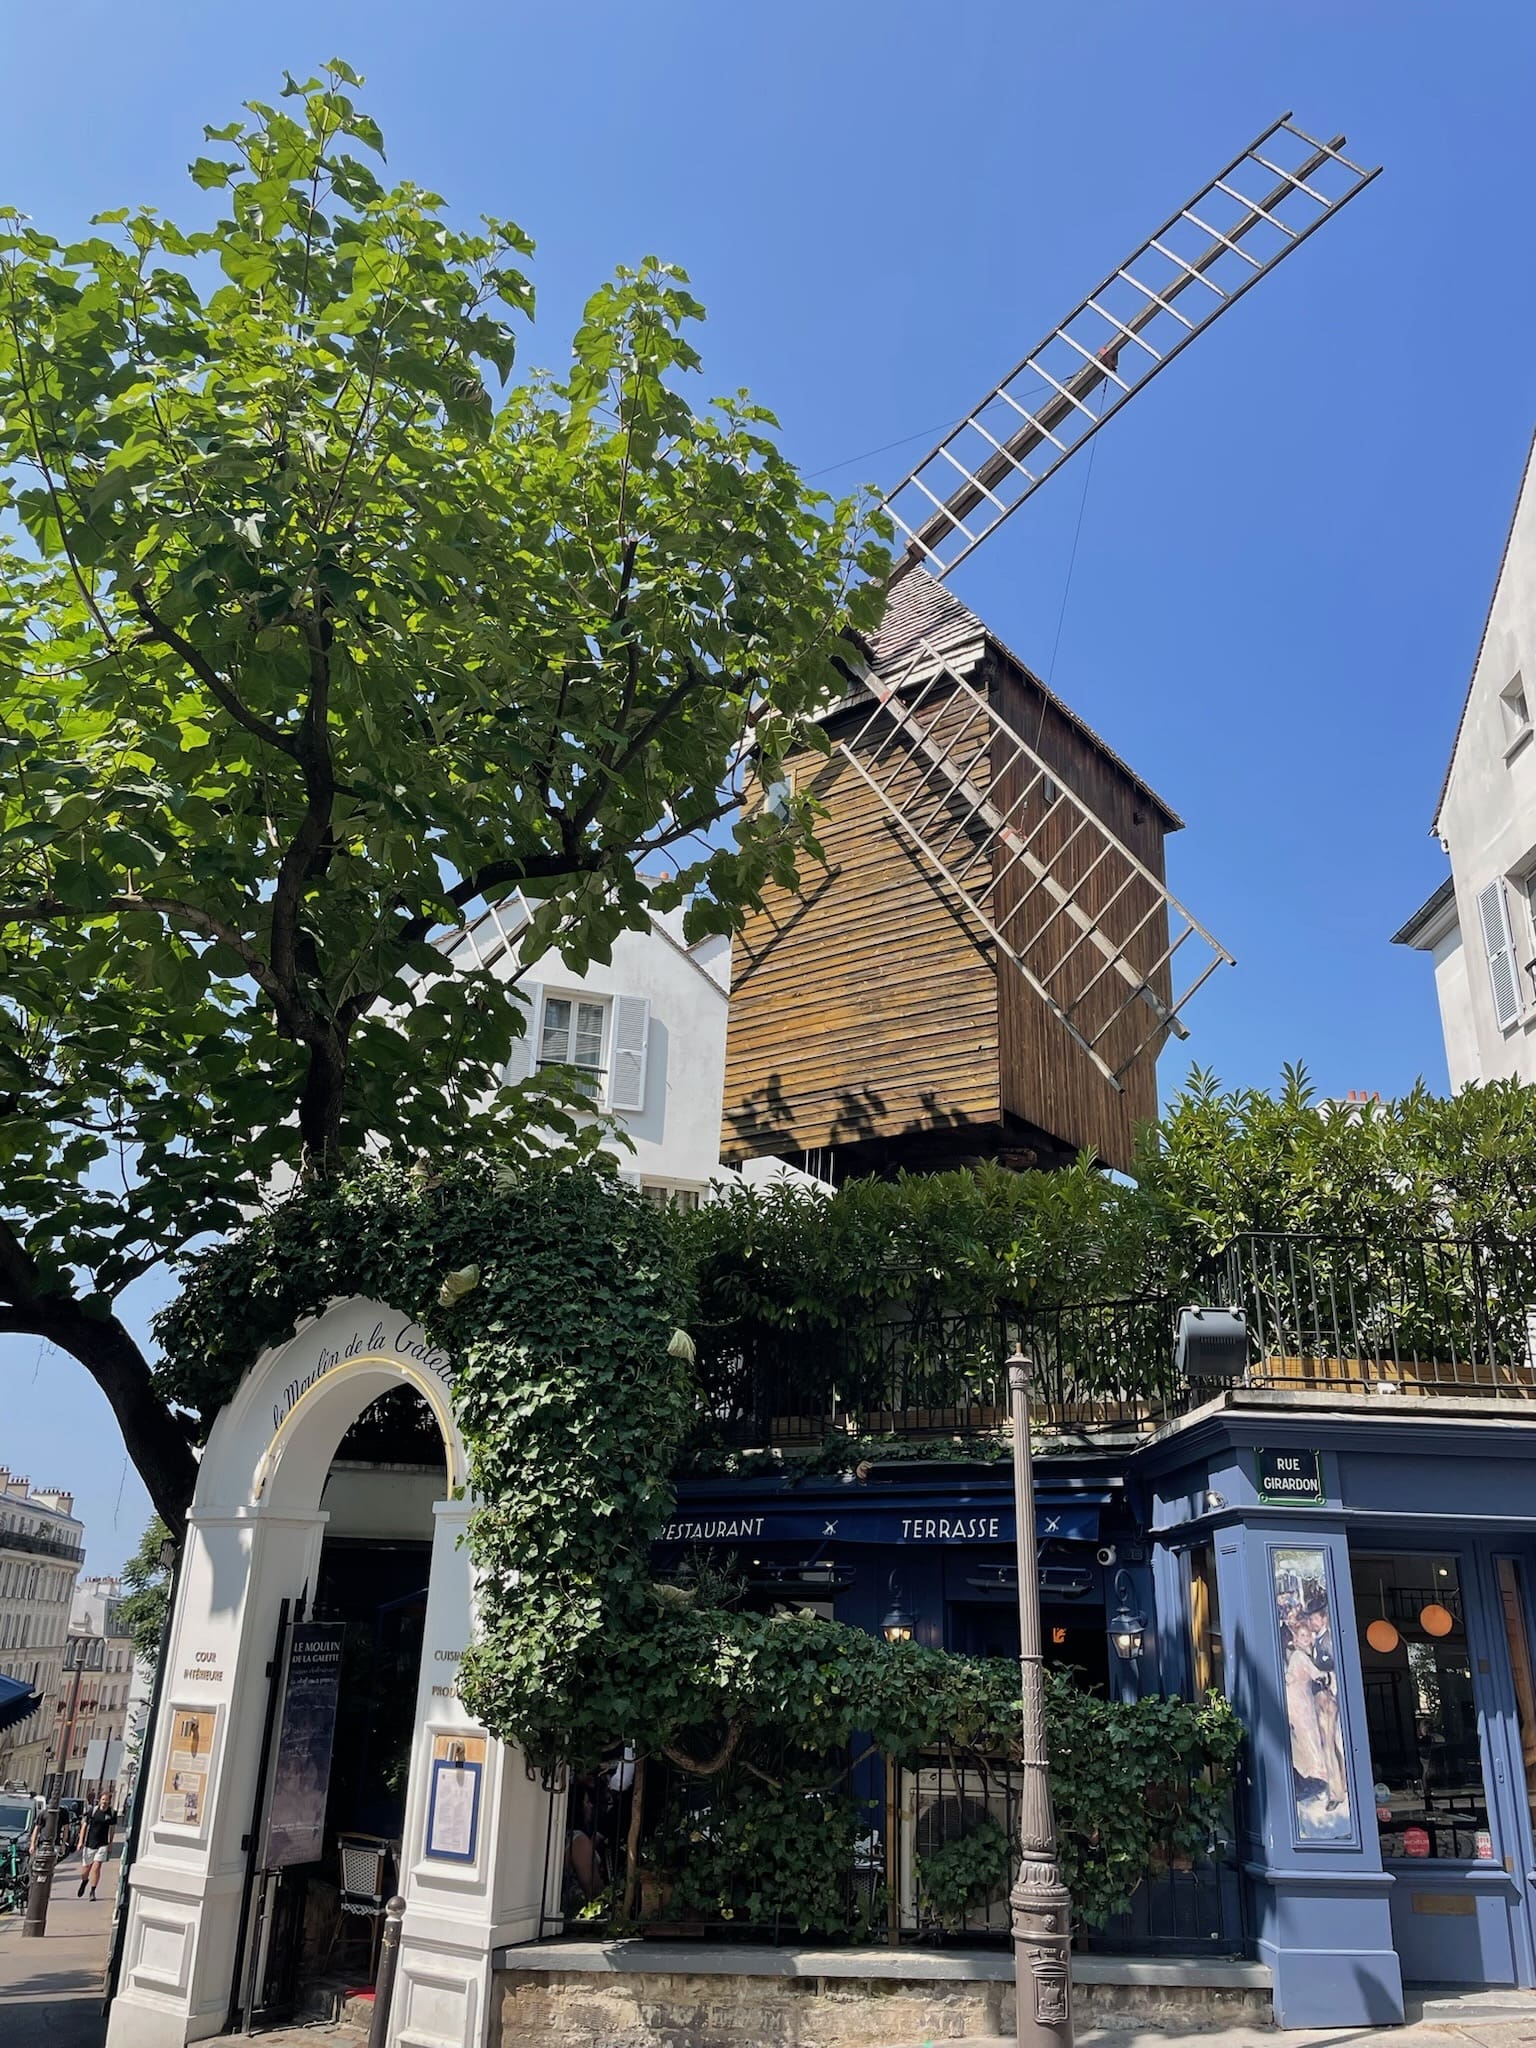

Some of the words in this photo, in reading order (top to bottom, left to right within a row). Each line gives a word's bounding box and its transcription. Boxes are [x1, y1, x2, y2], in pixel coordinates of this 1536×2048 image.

[283, 1348, 341, 1411] Moulin
[344, 1332, 363, 1359] de
[367, 1321, 387, 1352] la
[1276, 1457, 1301, 1471] RUE
[1263, 1476, 1319, 1491] GIRARDON
[902, 1518, 1000, 1539] TERRASSE
[293, 1642, 304, 1653] LE
[304, 1641, 341, 1653] MOULIN
[195, 1651, 217, 1663] COUR
[292, 1655, 302, 1664] DE
[302, 1655, 312, 1663] LA
[434, 1650, 465, 1661] CUISIN
